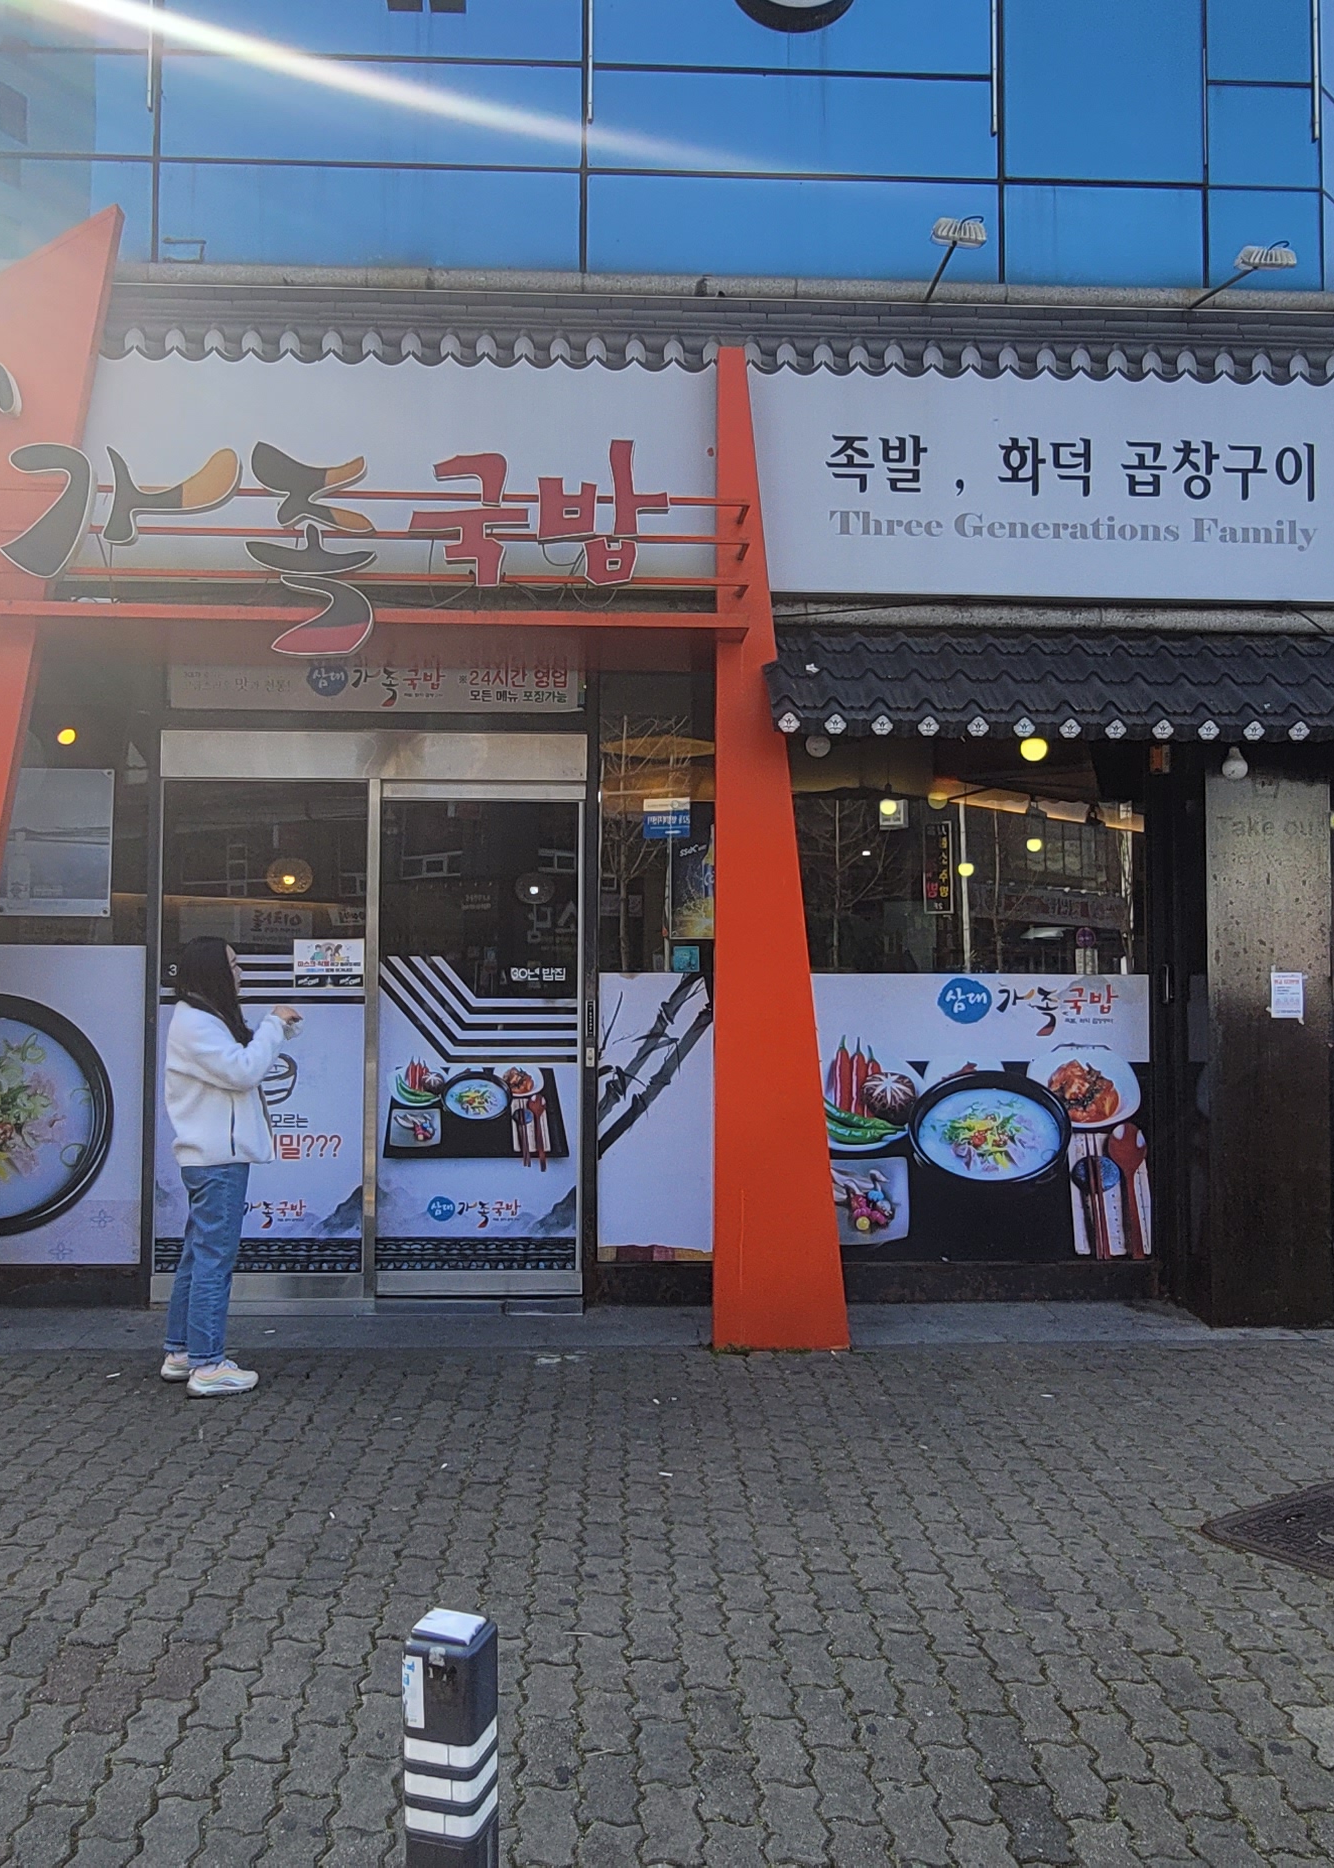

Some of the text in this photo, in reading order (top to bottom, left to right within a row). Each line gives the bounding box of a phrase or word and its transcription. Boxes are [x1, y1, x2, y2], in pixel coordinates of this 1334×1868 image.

[824, 433, 929, 495] 족발
[998, 436, 1093, 497] 화덕
[1120, 439, 1316, 502] 곱창구이
[829, 509, 1318, 552] Three Generations Family
[312, 667, 345, 689] 삼대
[534, 667, 568, 688] 영업
[469, 689, 568, 704] 모든 메뉴 포장가능
[944, 986, 988, 1014] 삼대
[270, 1113, 309, 1129] 모르는
[430, 1202, 455, 1215] 삼대
